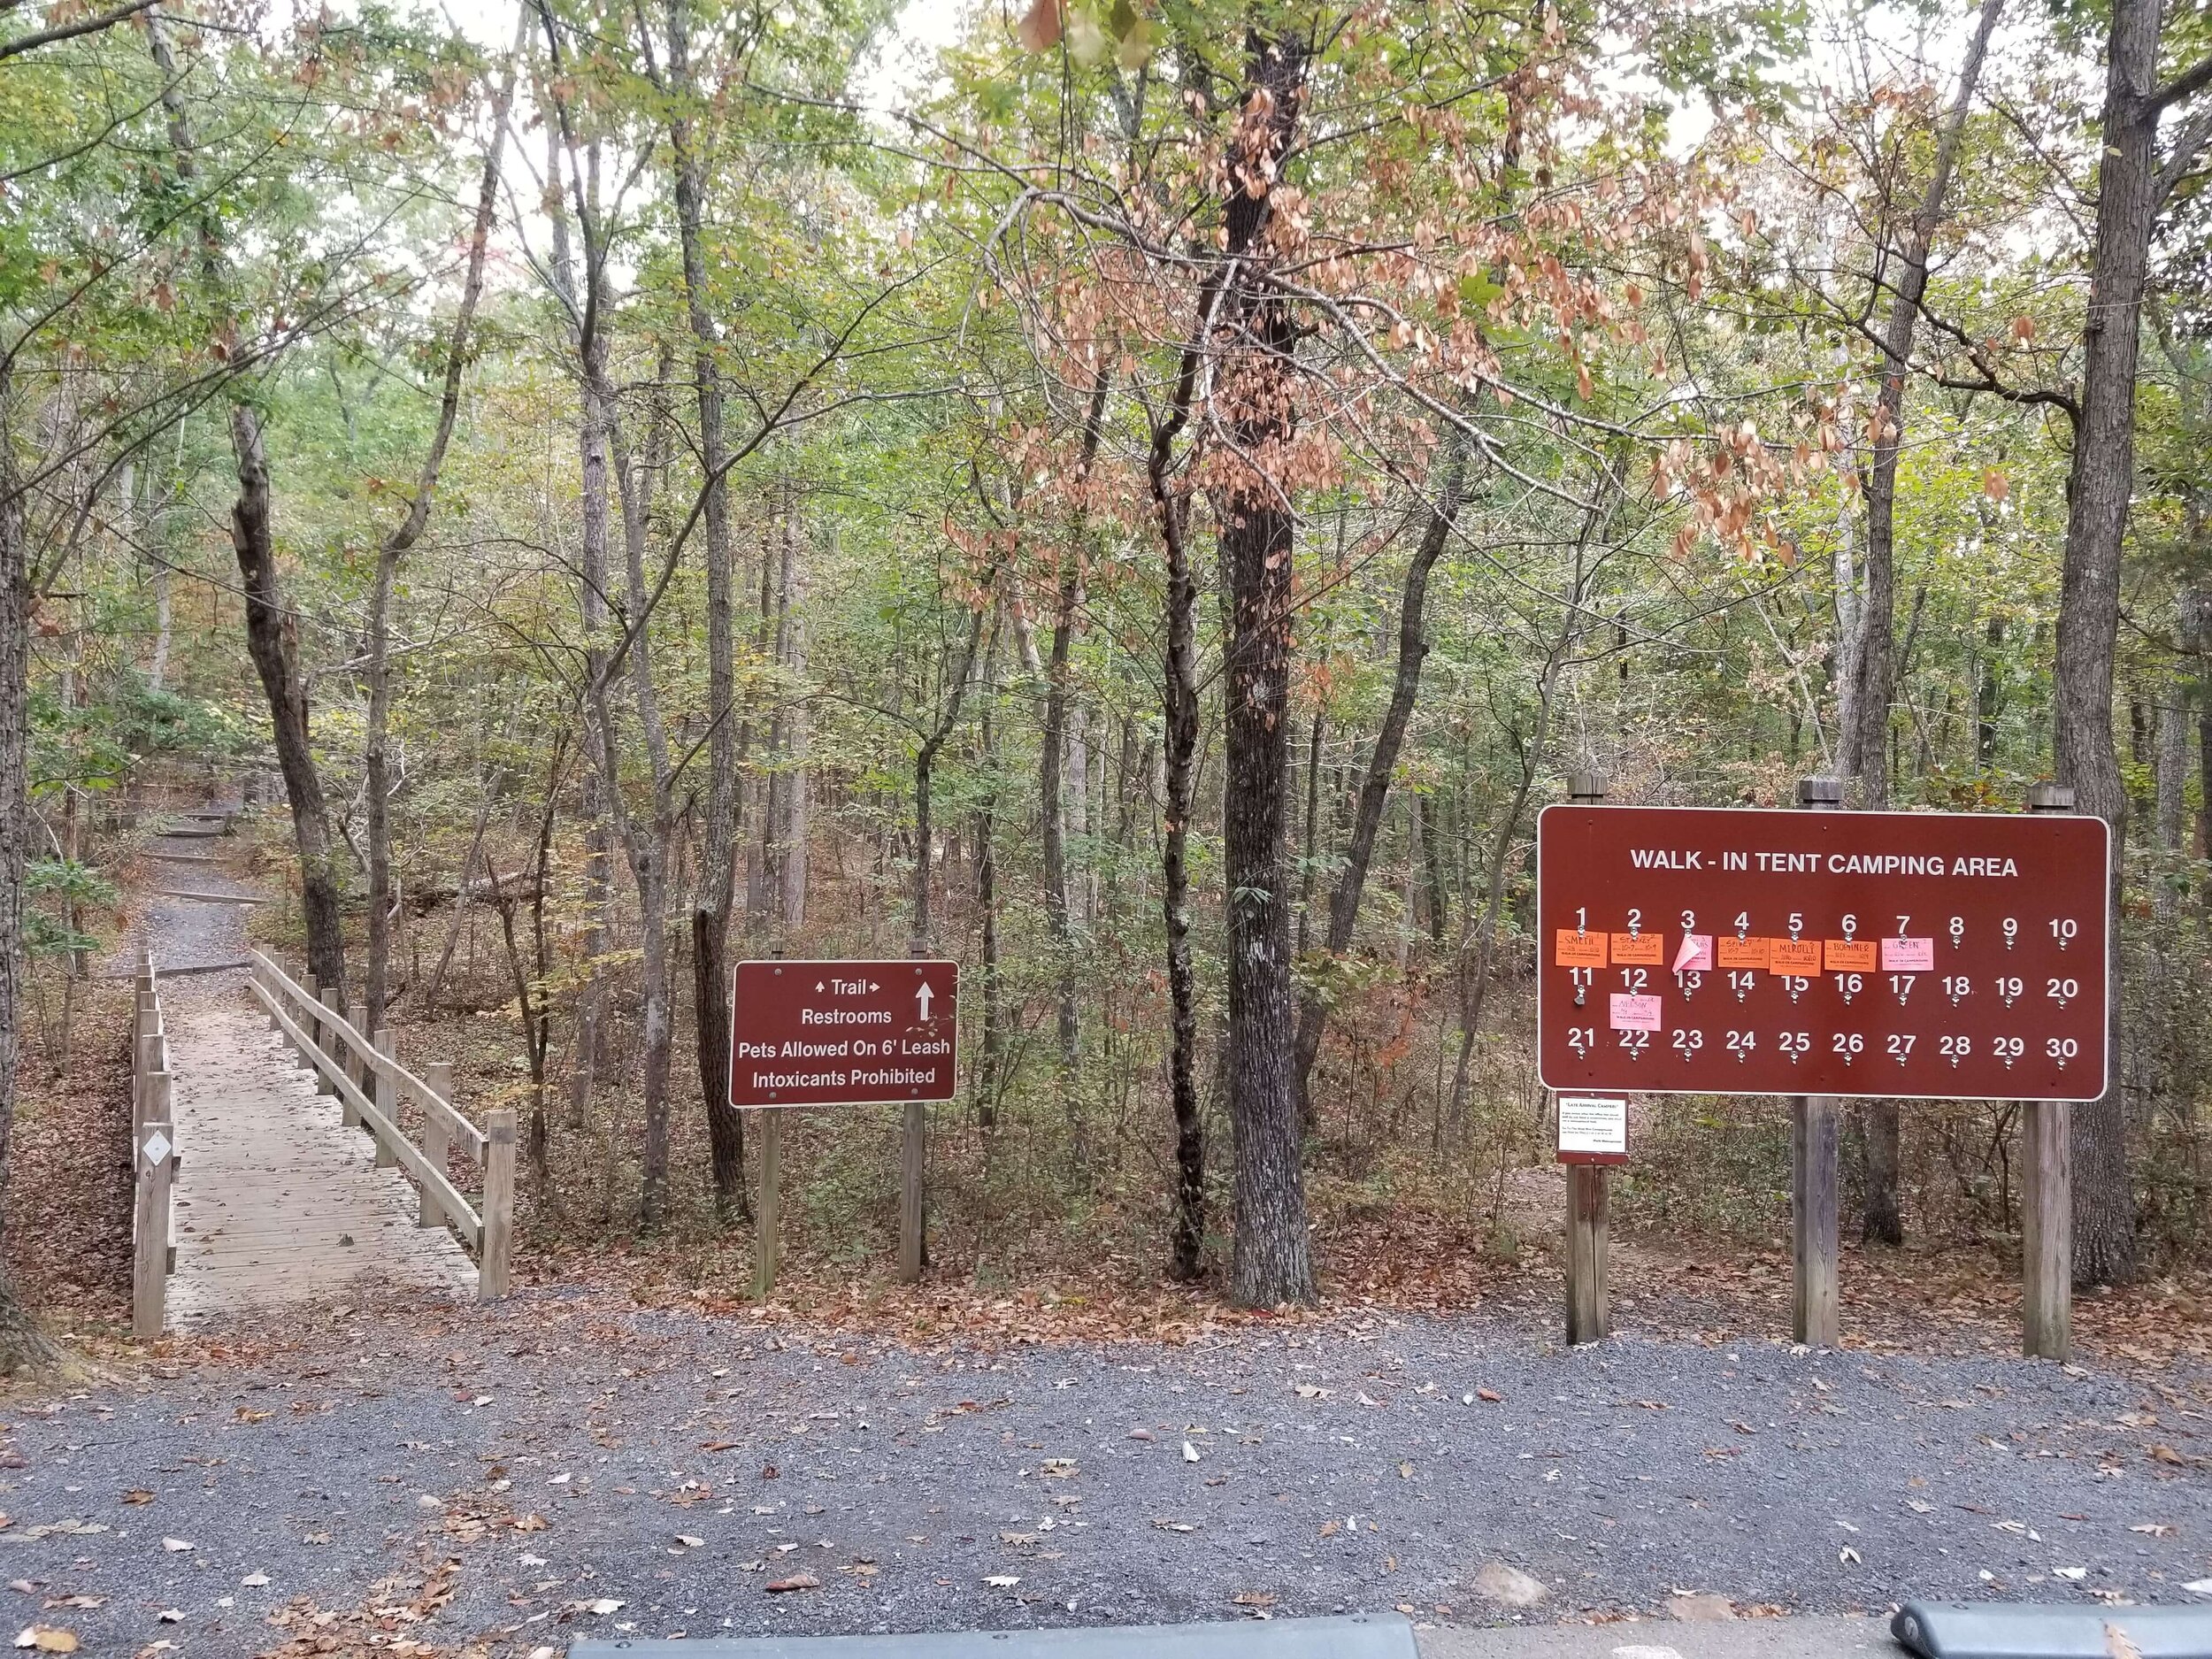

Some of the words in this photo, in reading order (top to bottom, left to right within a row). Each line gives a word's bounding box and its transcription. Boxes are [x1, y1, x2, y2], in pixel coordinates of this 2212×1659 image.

[1630, 849, 1702, 870] WALK
[1723, 851, 1747, 871] IN
[1755, 853, 1822, 872] TENT
[1828, 854, 1945, 876] CAMPING
[1951, 856, 2018, 877] AREA
[1576, 908, 1586, 926] 1
[1627, 908, 1641, 928] 2
[1680, 910, 1695, 929] 3
[1733, 911, 1750, 931] 4
[1787, 912, 1803, 932] 5
[1841, 914, 1857, 933] 6
[1896, 915, 1910, 934] 7
[1948, 916, 1964, 936] 8
[2002, 917, 2018, 937] 9
[2048, 918, 2078, 938] 10
[1569, 966, 1593, 987] 11
[1620, 967, 1647, 988] 12
[1675, 970, 1701, 989] 13
[1727, 971, 1755, 990] 14
[1780, 975, 1809, 992] 15
[1834, 973, 1863, 994] 16
[1888, 974, 1916, 994] 17
[1941, 976, 1970, 996] 18
[831, 979, 866, 995] Trail
[1994, 977, 2024, 997] 19
[2047, 978, 2078, 998] 20
[802, 1008, 892, 1025] Restrooms
[1568, 1027, 1594, 1048] 21
[1618, 1029, 1651, 1048] 22
[1671, 1029, 1703, 1049] 23
[1725, 1030, 1756, 1050] 24
[1778, 1032, 1810, 1051] 25
[1832, 1033, 1864, 1053] 26
[1886, 1034, 1916, 1055] 27
[1939, 1035, 1971, 1056] 28
[1993, 1036, 2024, 1056] 29
[739, 1041, 777, 1059] Pets
[780, 1040, 849, 1057] Allowed
[853, 1040, 877, 1056] On
[881, 1039, 897, 1056] 6'
[902, 1038, 950, 1055] Leash
[2046, 1038, 2078, 1058] 30
[753, 1070, 846, 1088] Intoxicants
[850, 1067, 935, 1086] Prohibited
